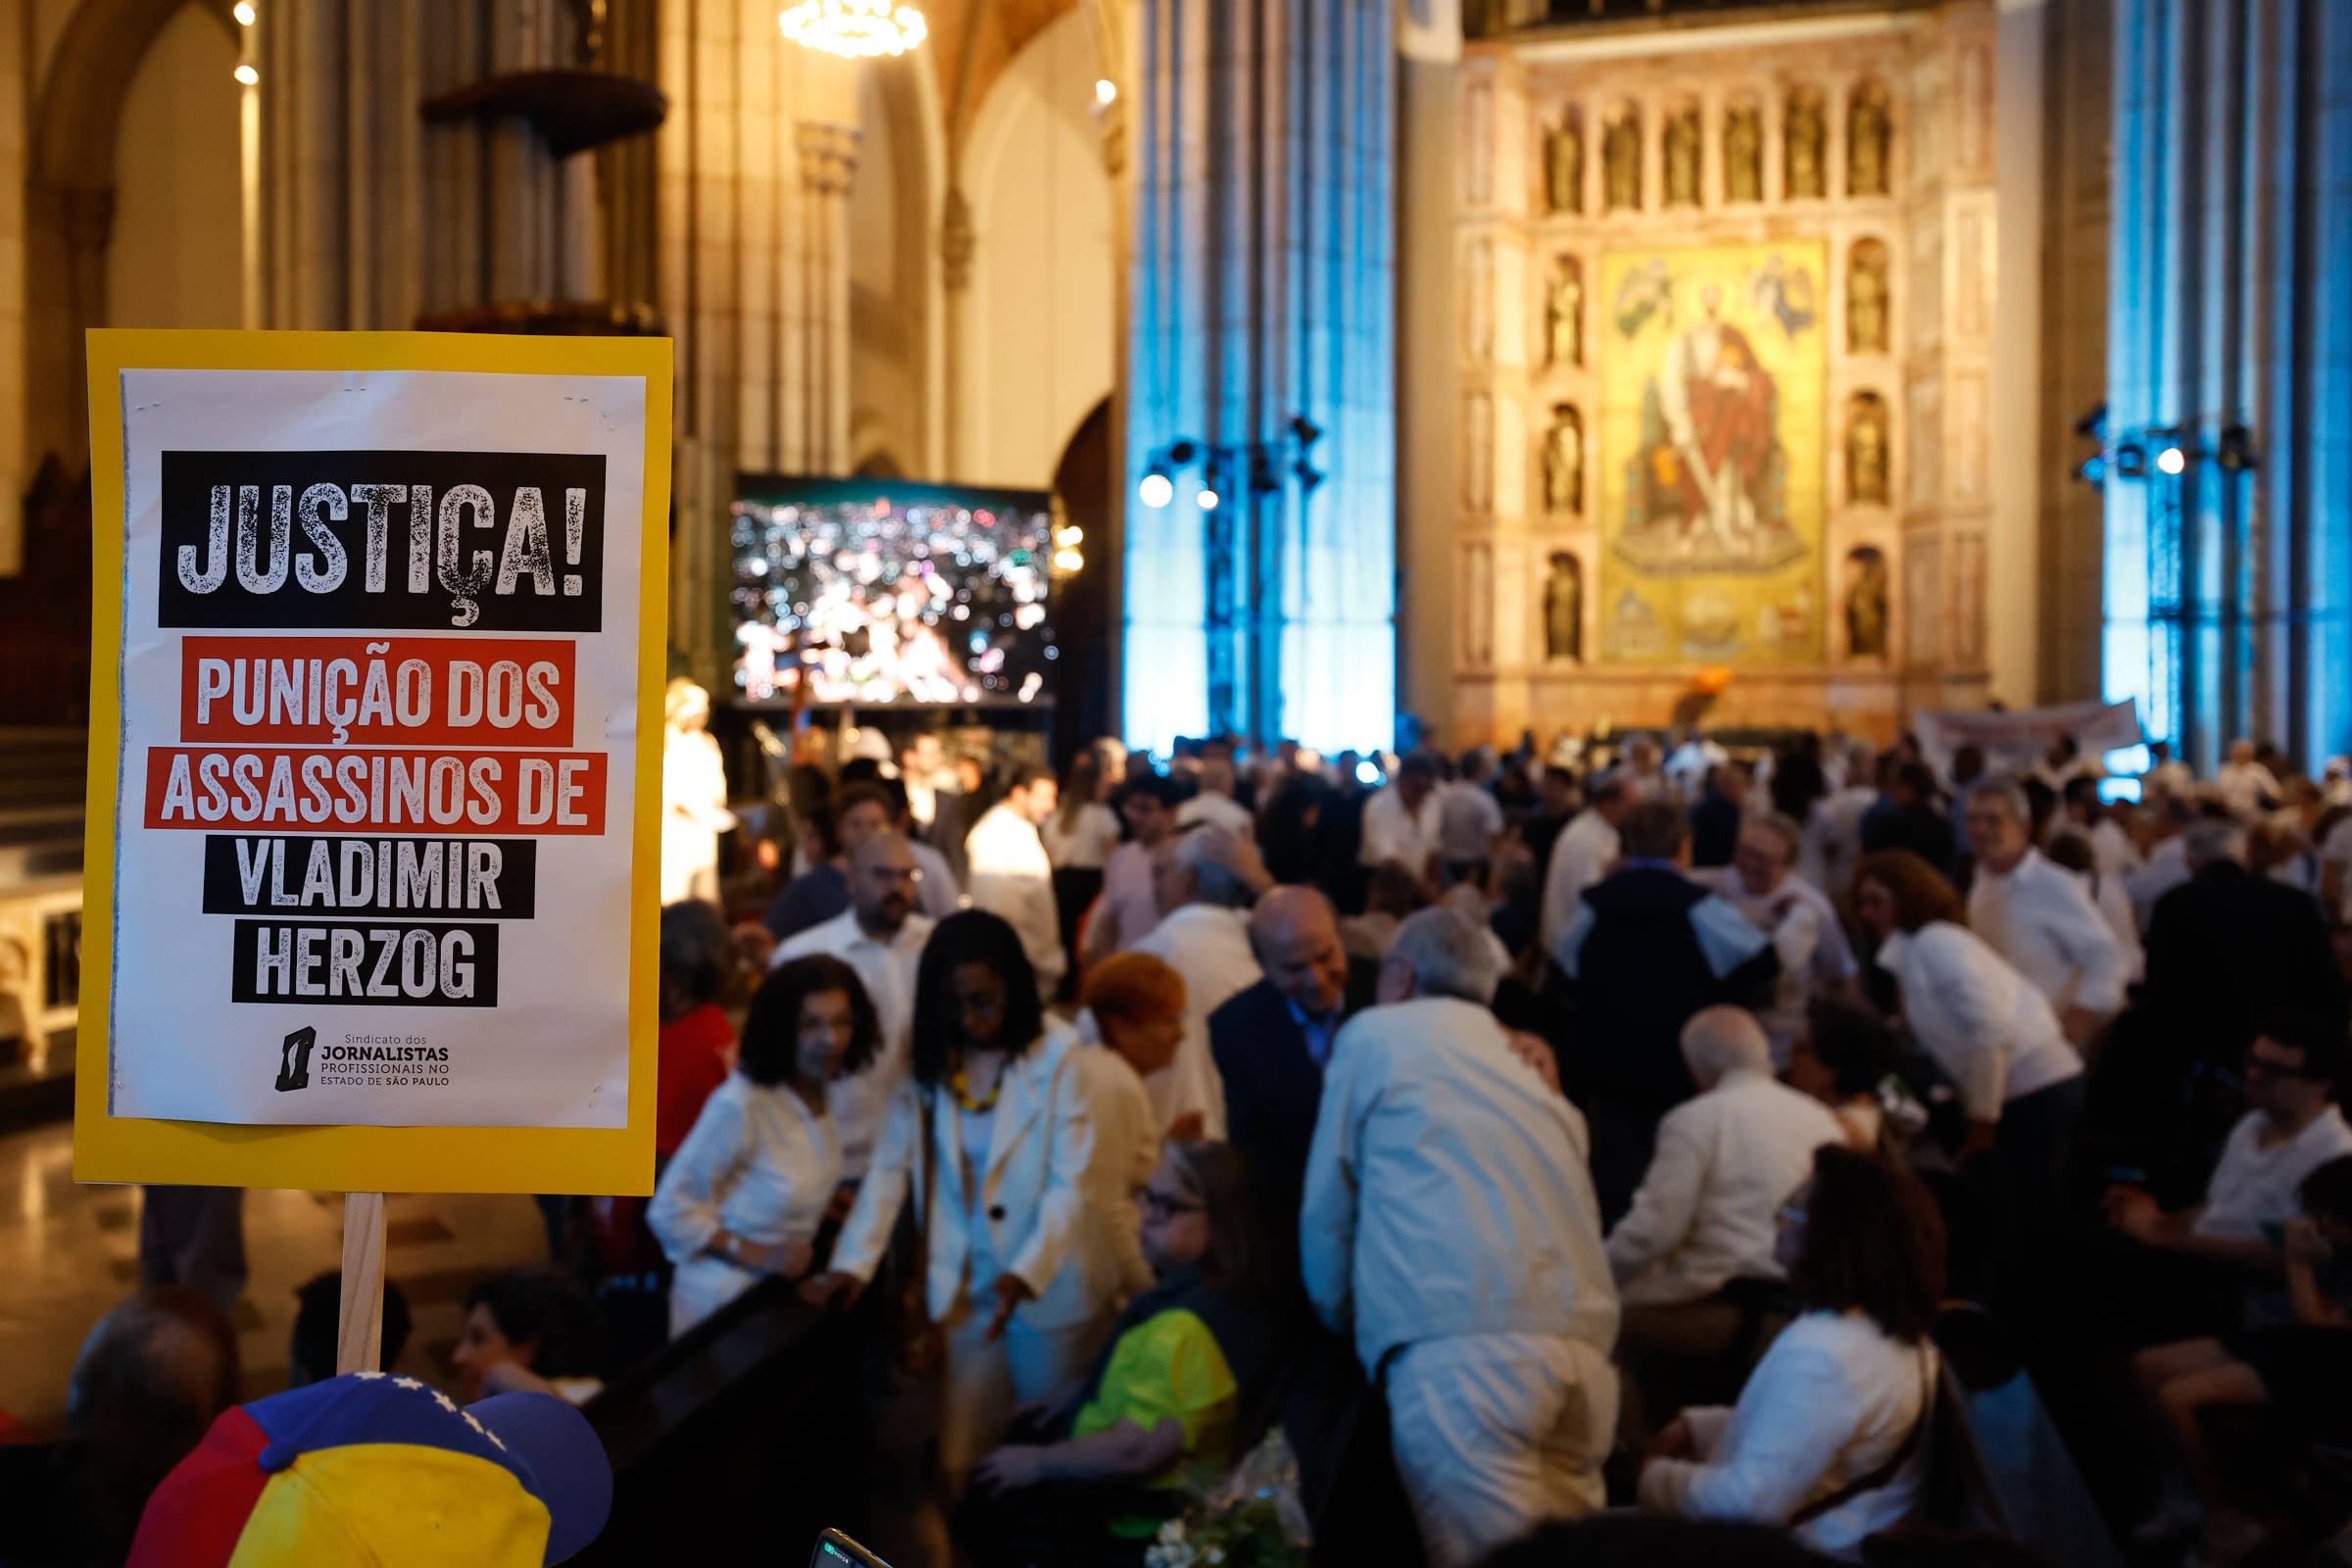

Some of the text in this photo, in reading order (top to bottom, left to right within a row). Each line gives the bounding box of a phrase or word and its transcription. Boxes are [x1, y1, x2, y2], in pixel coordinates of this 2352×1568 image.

[177, 482, 586, 626] JUSTIÇA!
[197, 642, 560, 745] PUNIÇÃO DOS
[161, 753, 589, 826] ASSASSINOS DE
[235, 838, 503, 909] VLADIMIR
[256, 927, 475, 999] HERZOG
[320, 1063, 449, 1074] PROFISSIONAIS NO
[321, 1046, 449, 1061] JORNALISTAS
[345, 1034, 427, 1045] Sindicato dos
[320, 1075, 449, 1086] ESTADO DE SÃO PAULO
